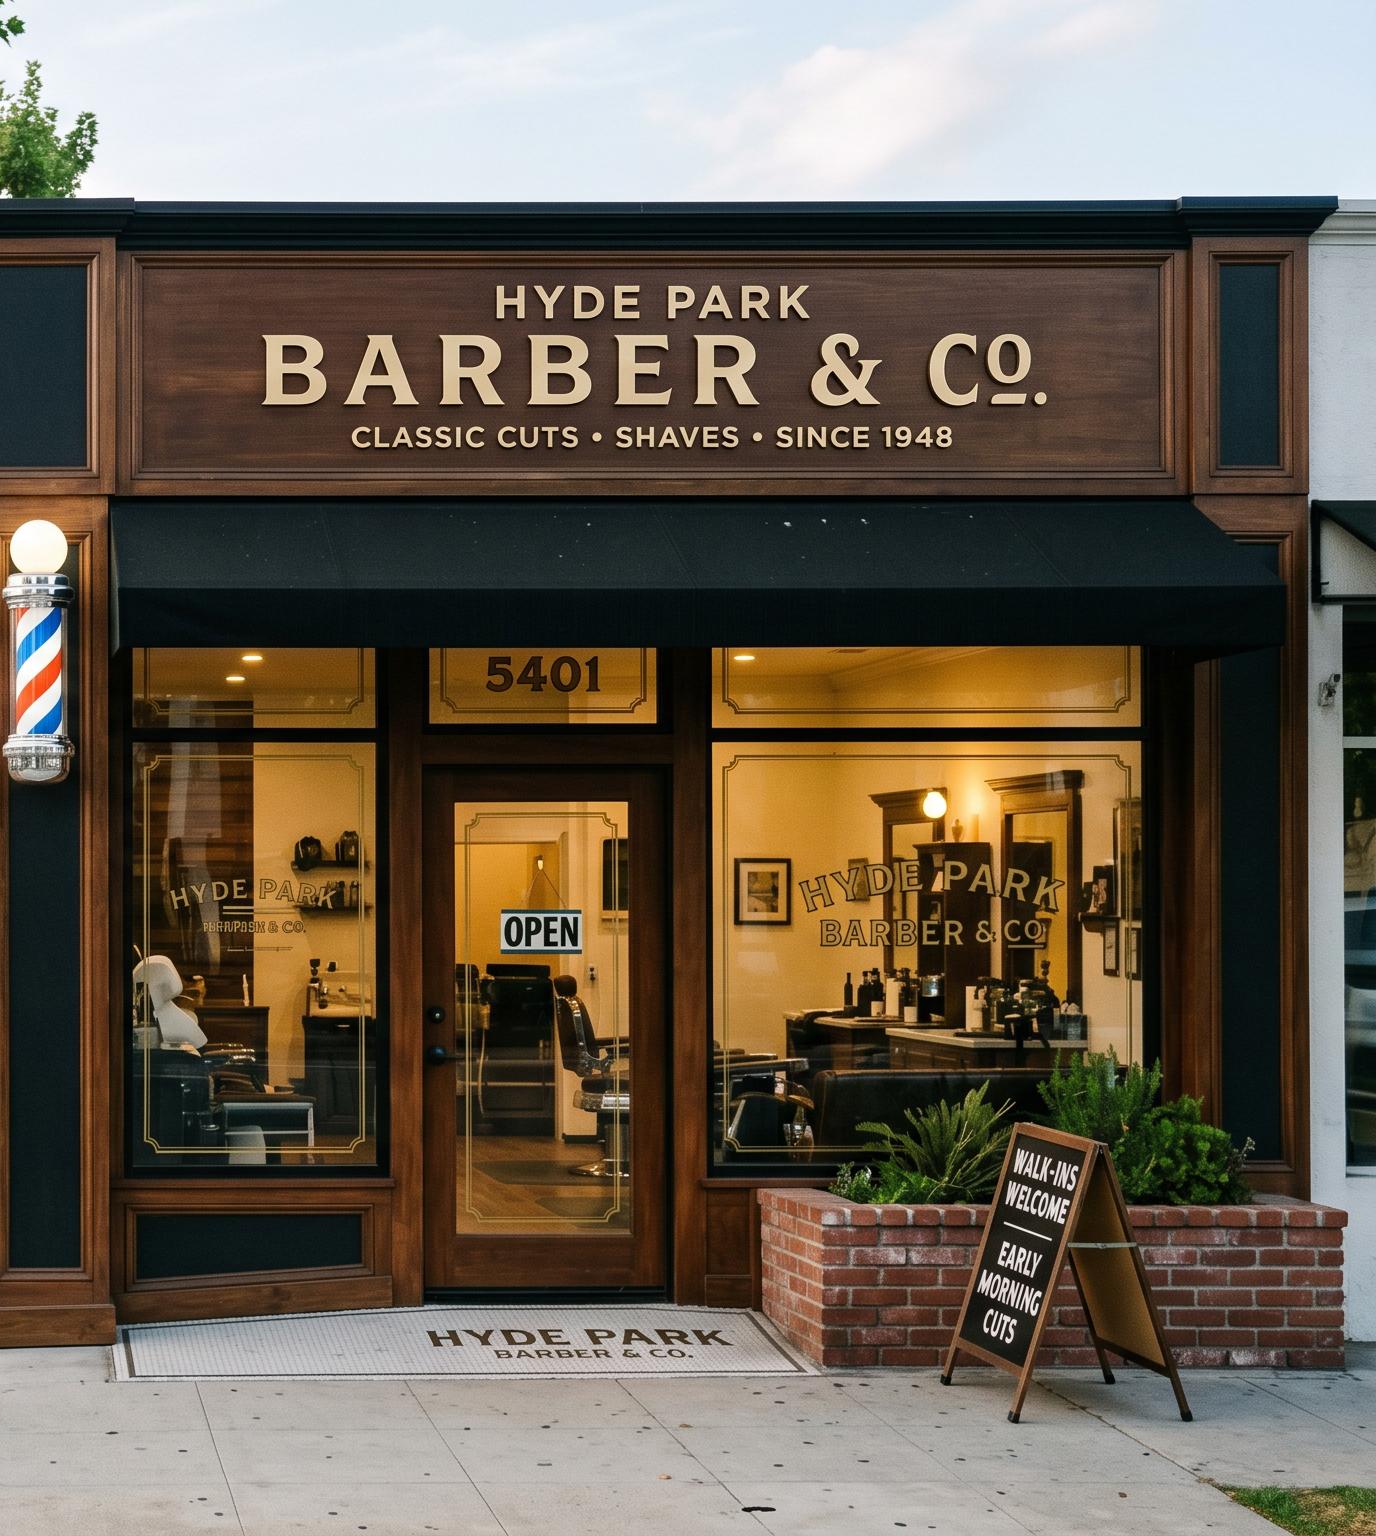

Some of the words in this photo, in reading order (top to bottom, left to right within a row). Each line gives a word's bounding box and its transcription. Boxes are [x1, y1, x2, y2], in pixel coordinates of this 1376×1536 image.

[496, 285, 641, 320] HYDE
[667, 284, 812, 320] PARK
[261, 334, 761, 406] BARBER
[810, 333, 884, 407] &
[351, 426, 485, 449] CLASSIC
[497, 426, 579, 449] CUTS
[615, 426, 739, 449] SHAVES
[775, 426, 870, 449] SINCE
[881, 426, 953, 449] 1948
[486, 656, 600, 692] 5401
[170, 879, 248, 910] HYDE
[259, 879, 337, 909] PARK
[799, 860, 923, 912] HYDE
[943, 860, 1065, 912] PARK
[504, 916, 579, 947] OPEN
[820, 919, 963, 947] BARBER
[975, 920, 996, 943] &
[1013, 1148, 1079, 1192] WALK-INS
[1005, 1180, 1070, 1225] WELCOME
[997, 1240, 1043, 1279] EARLY
[976, 1269, 1043, 1317] MORNING
[426, 1329, 571, 1347] HYDE
[584, 1329, 734, 1347] PARK
[982, 1308, 1018, 1344] CUTS
[494, 1349, 611, 1359] BARBER
[622, 1349, 642, 1359] &
[648, 1349, 694, 1359] CO.
